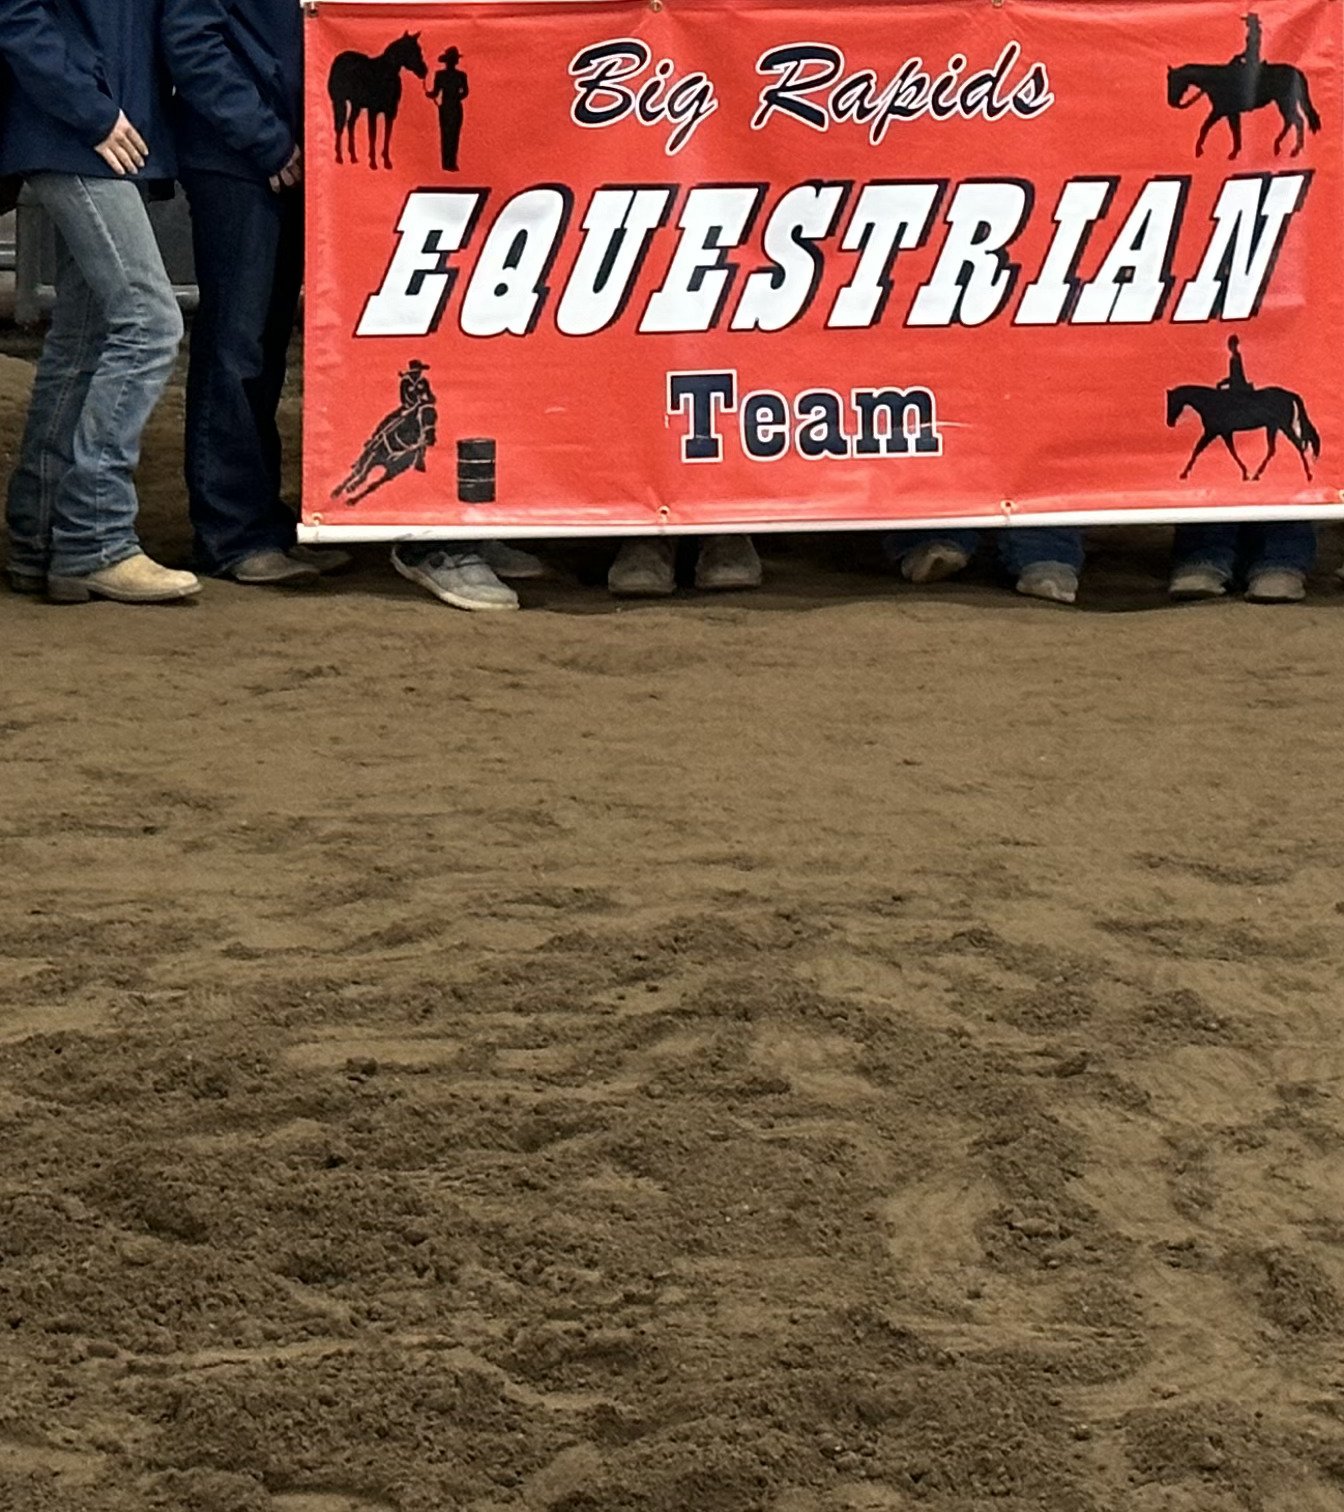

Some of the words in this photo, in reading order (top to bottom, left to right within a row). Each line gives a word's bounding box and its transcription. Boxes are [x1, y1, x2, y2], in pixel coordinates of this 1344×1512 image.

[568, 37, 718, 156] Big
[750, 40, 1055, 146] Rapids
[353, 170, 1316, 338] EQUESTRIAN
[666, 368, 943, 464] Team
